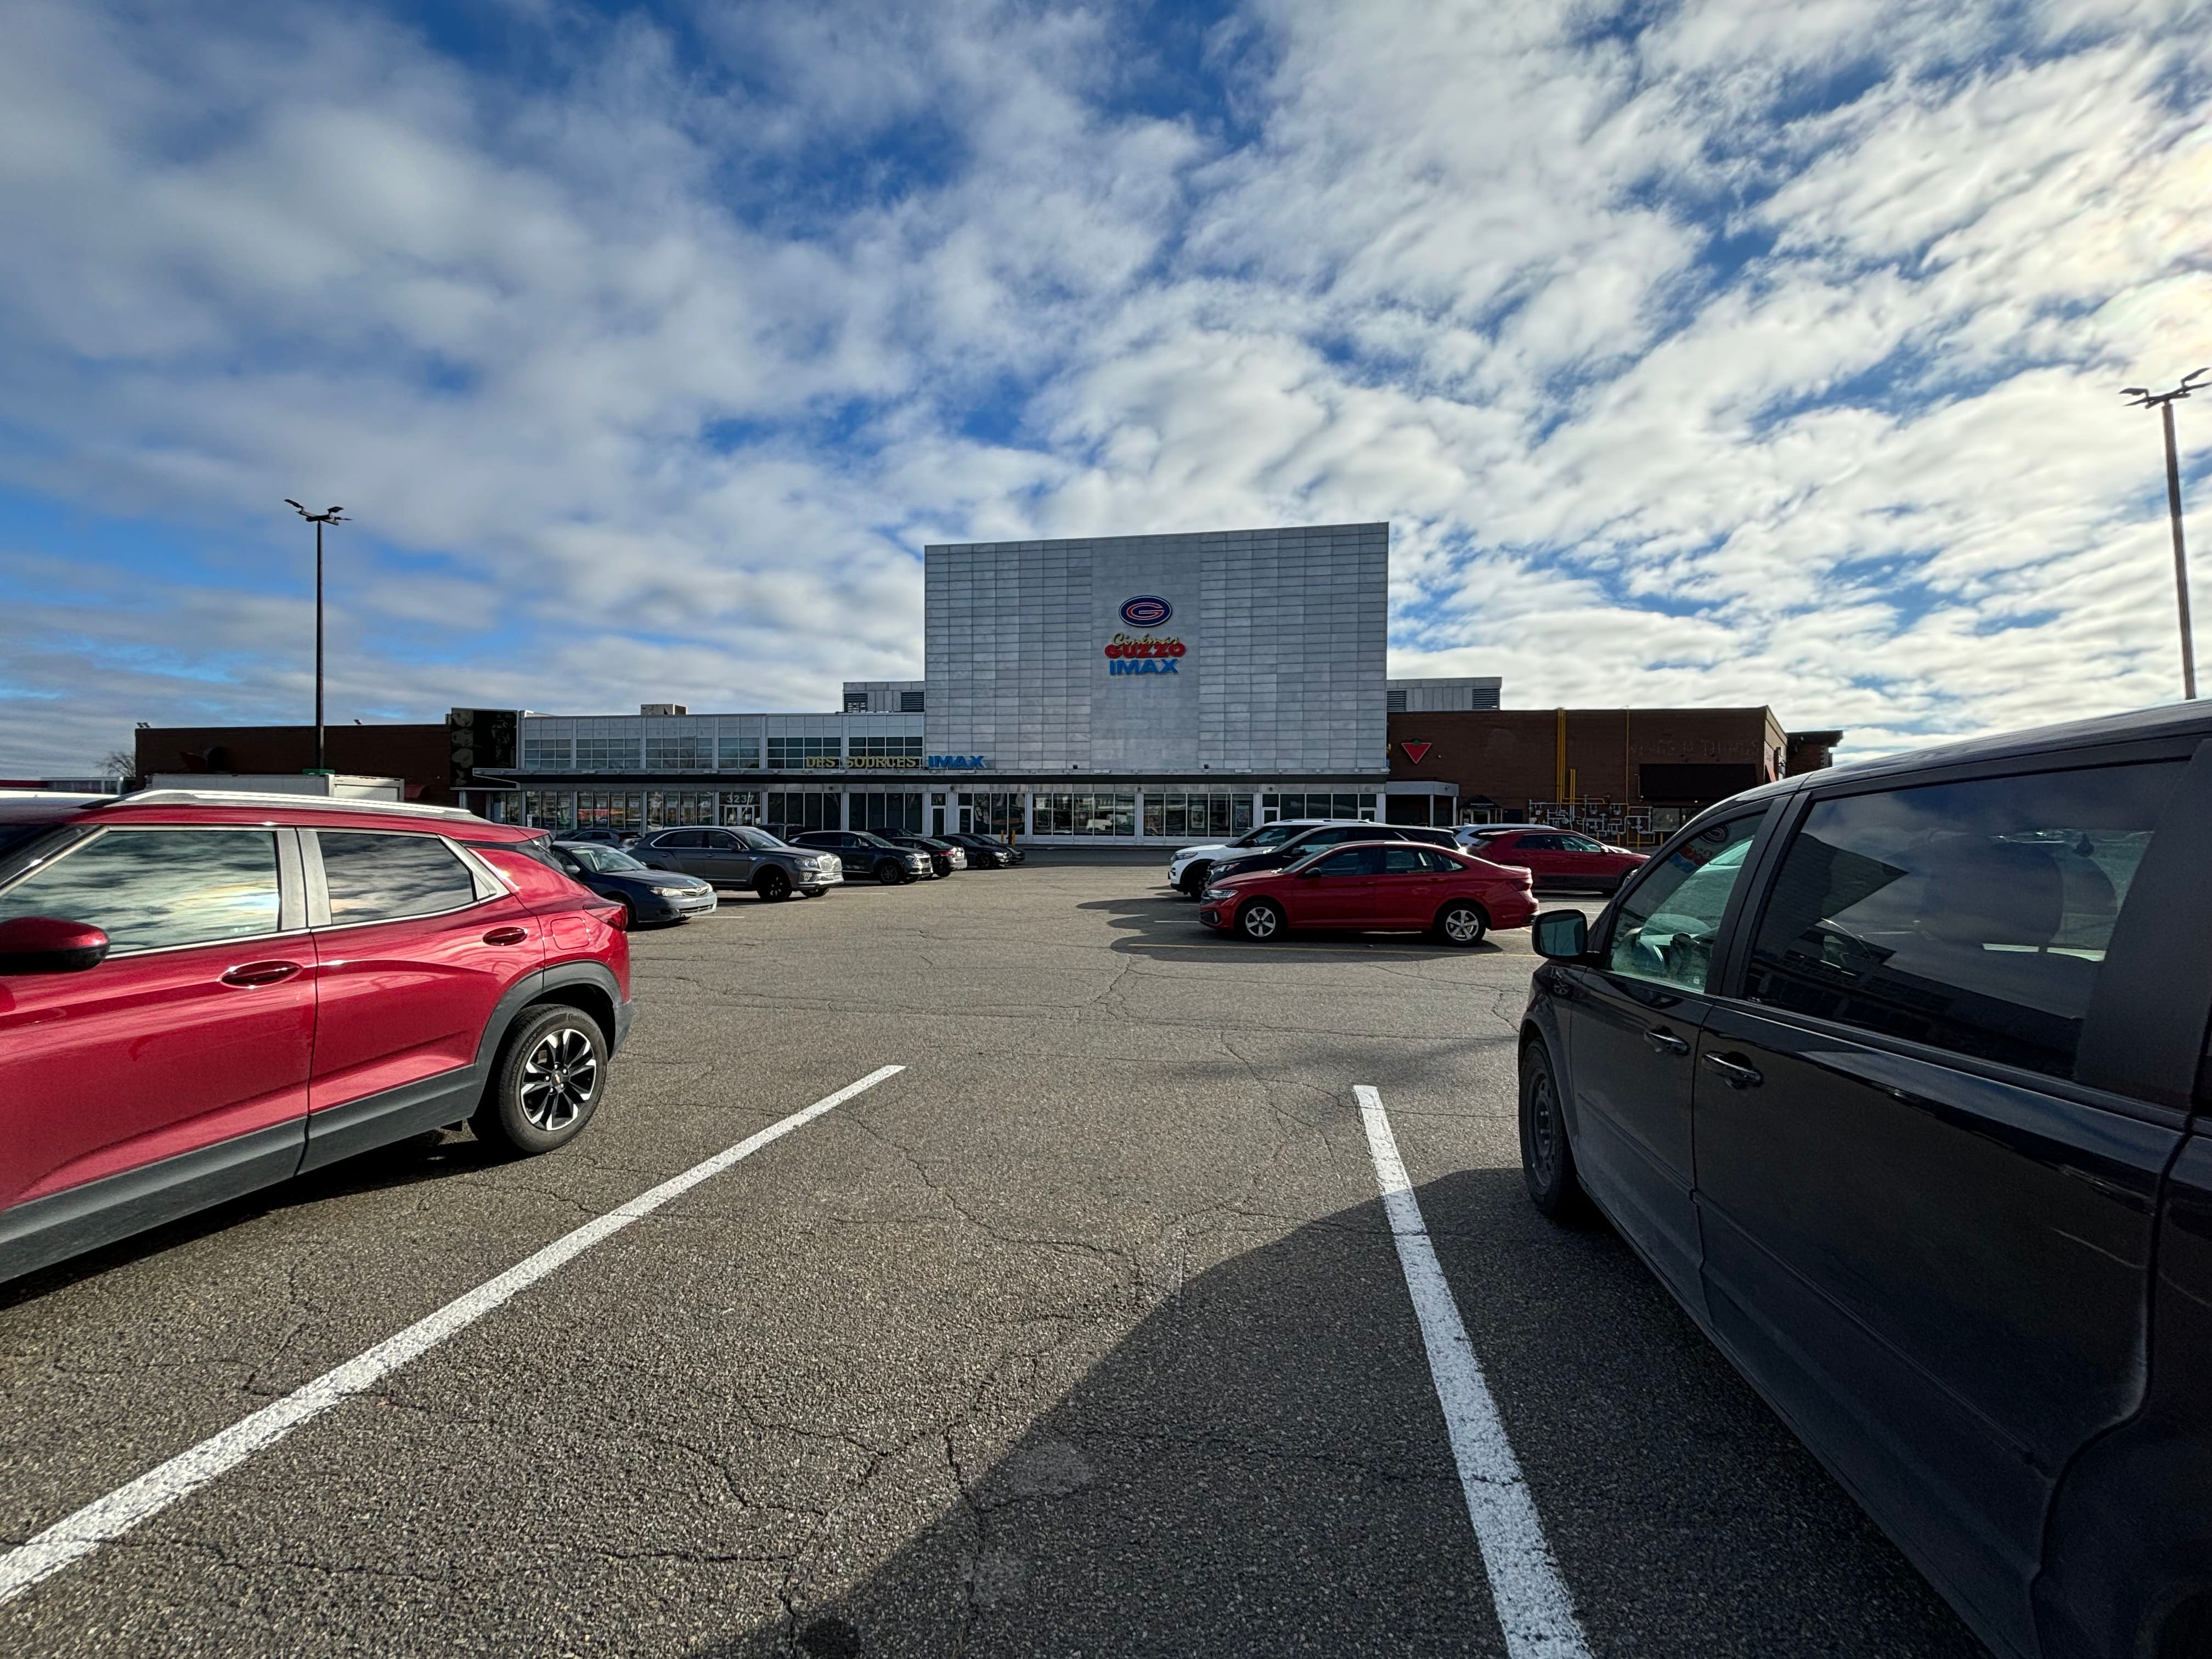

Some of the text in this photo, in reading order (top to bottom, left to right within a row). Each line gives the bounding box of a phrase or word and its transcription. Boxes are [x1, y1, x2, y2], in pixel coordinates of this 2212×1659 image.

[1113, 632, 1180, 646] Cinémas
[1105, 642, 1186, 658] GUZZO
[1109, 659, 1179, 675] IMAX
[806, 755, 986, 768] DES SOURCES IMAX
[726, 794, 754, 803] 3237
